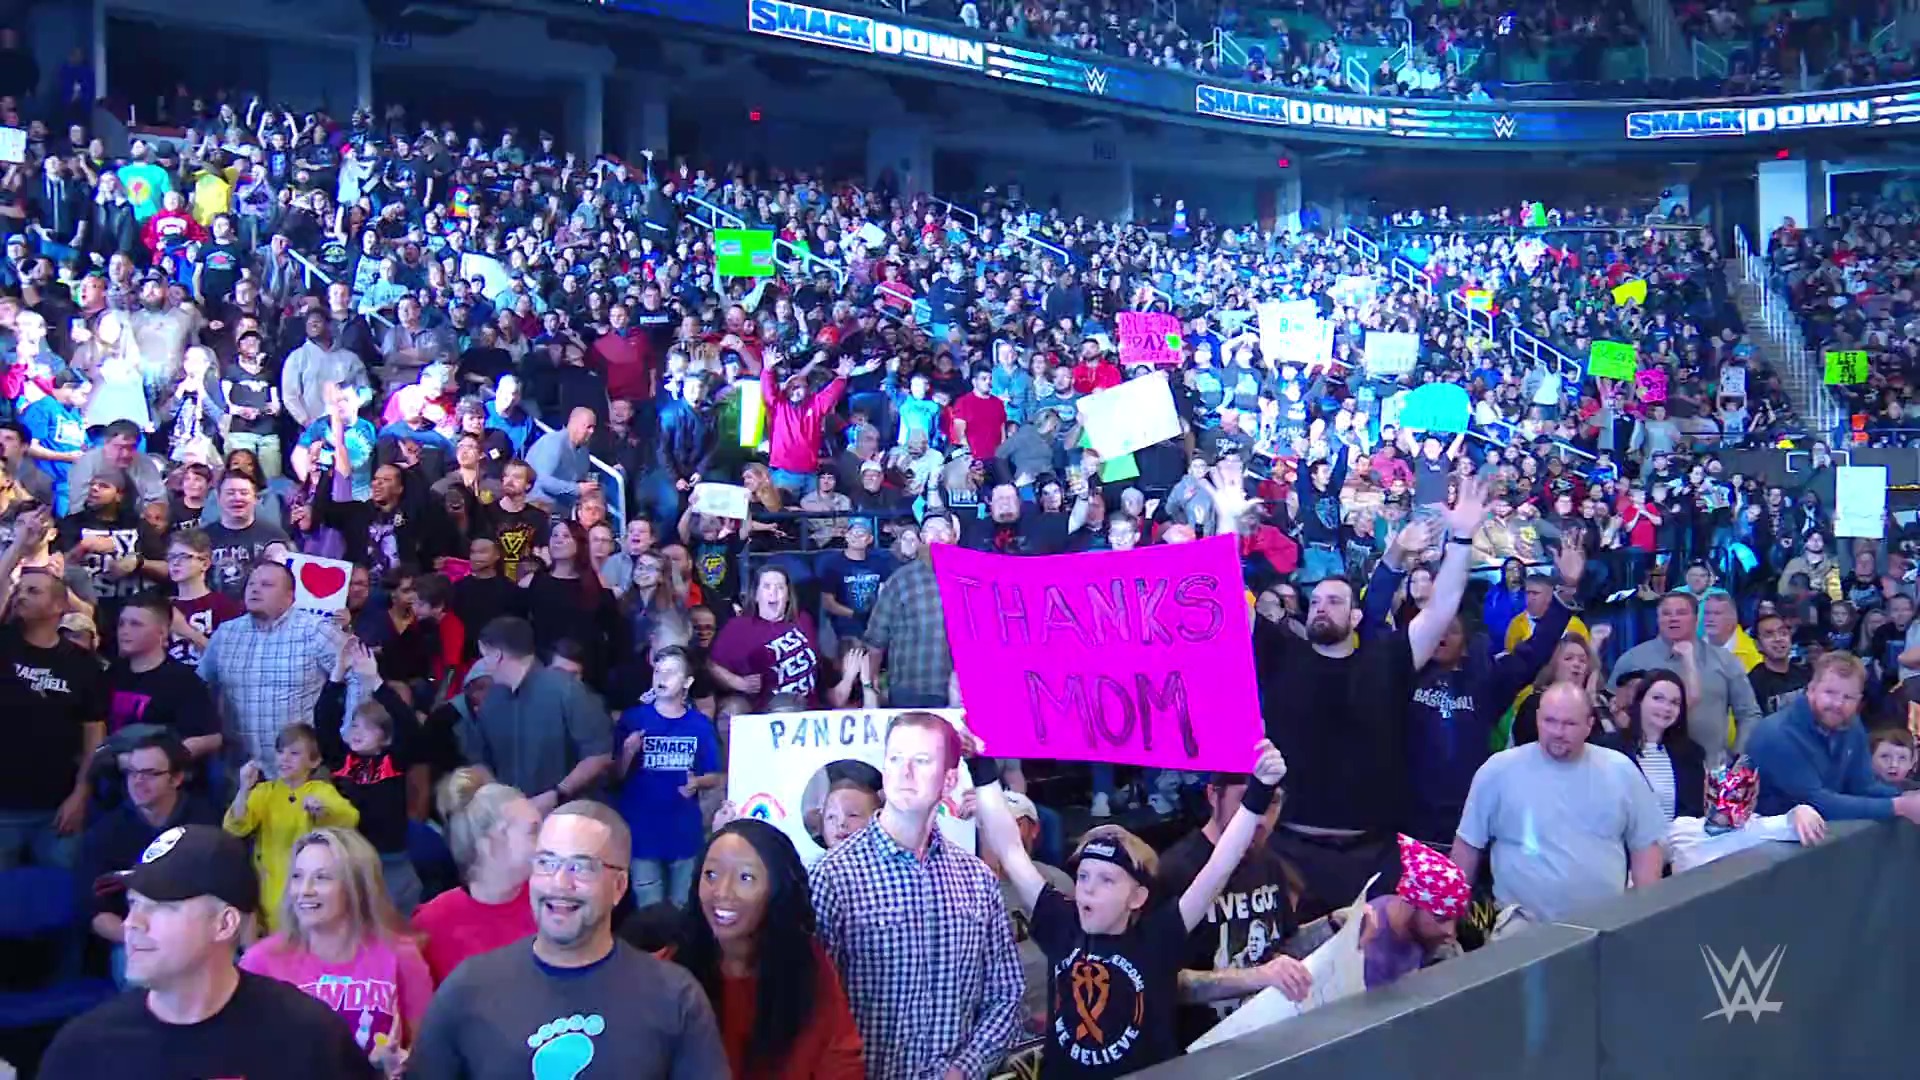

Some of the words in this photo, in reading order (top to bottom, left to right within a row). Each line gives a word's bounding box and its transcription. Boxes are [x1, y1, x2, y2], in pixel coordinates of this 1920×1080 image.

[950, 574, 1224, 647] THANKS
[764, 627, 808, 662] YES!
[769, 647, 817, 685] YES!
[770, 714, 896, 750] PANCA
[1024, 669, 1199, 759] MOM
[644, 737, 697, 752] SMACK
[645, 753, 694, 769] DOWN
[1055, 1016, 1070, 1047] WE
[1070, 1026, 1139, 1065] BELIEVE
